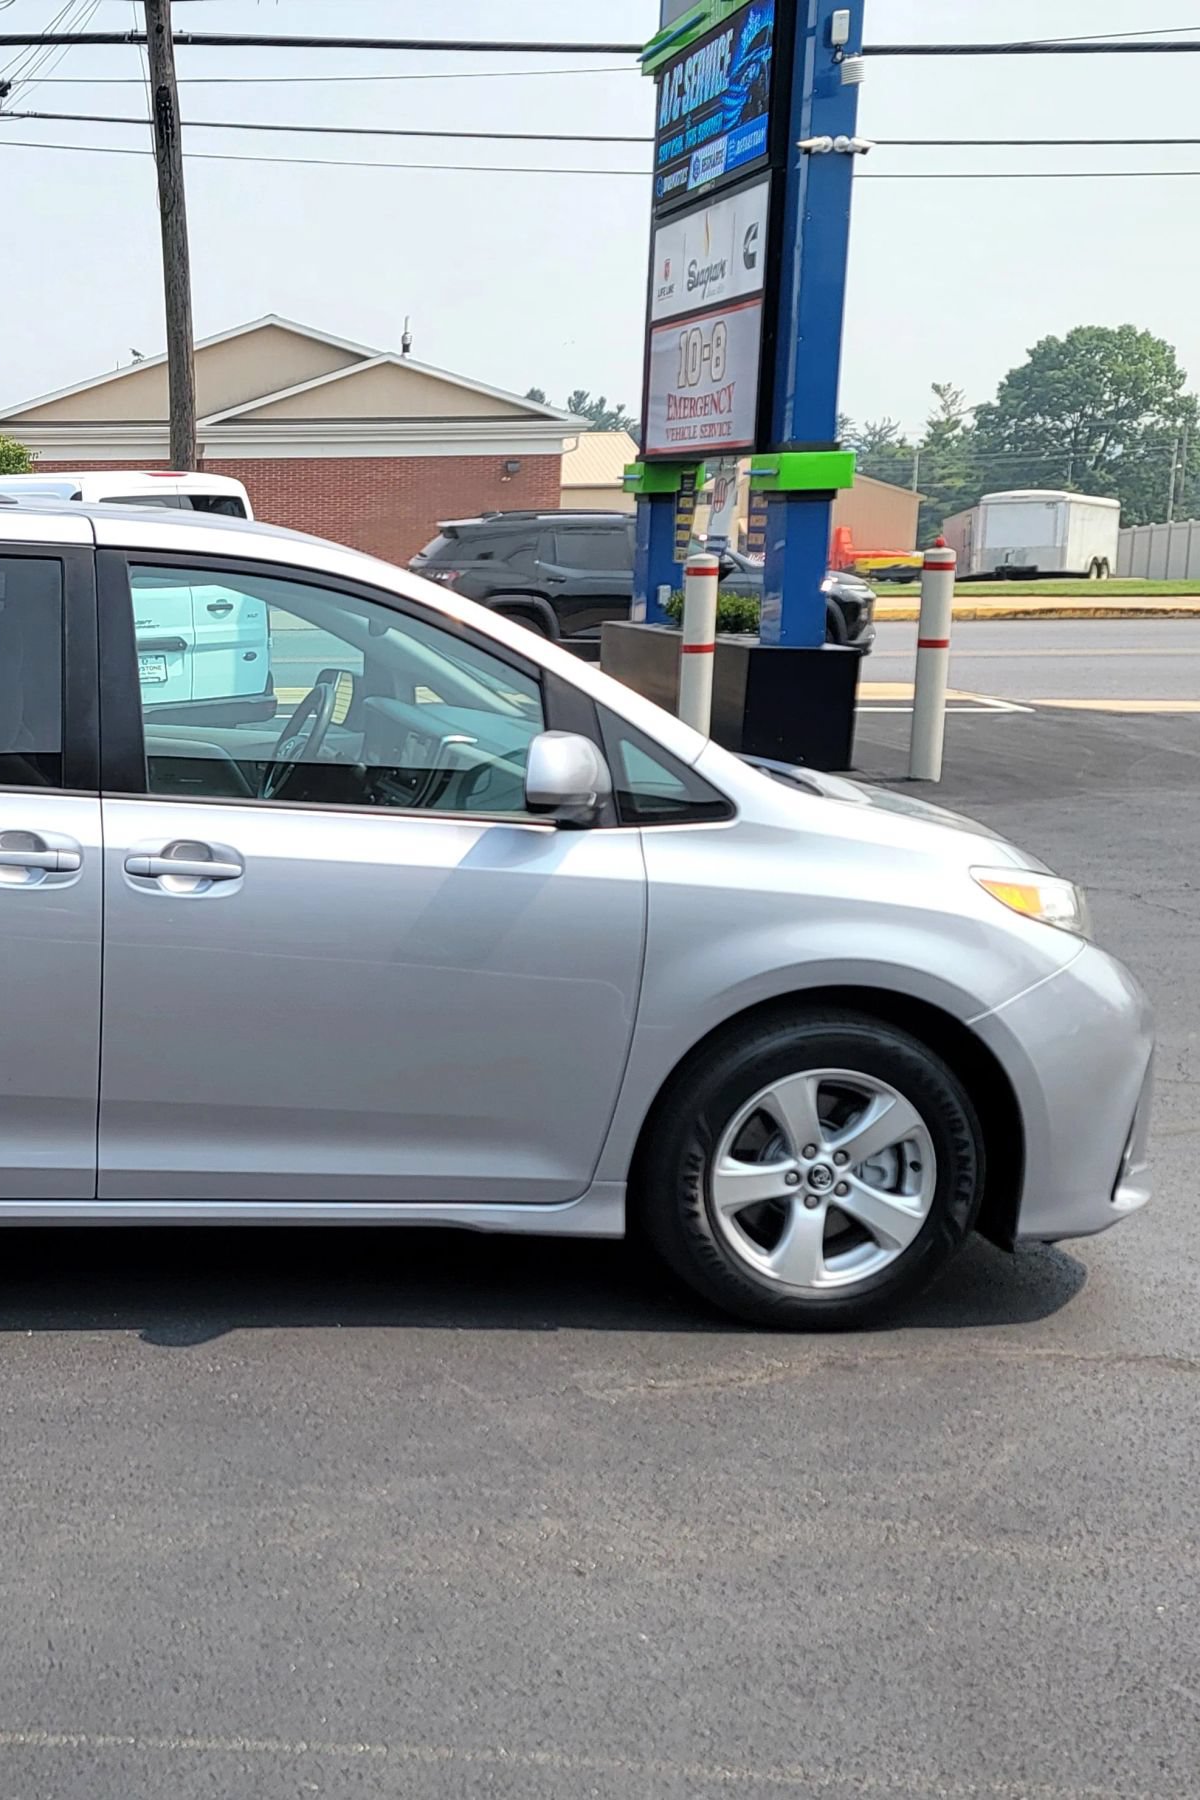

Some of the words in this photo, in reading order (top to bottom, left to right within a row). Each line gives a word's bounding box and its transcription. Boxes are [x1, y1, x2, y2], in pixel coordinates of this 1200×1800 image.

[659, 63, 684, 130] A/C
[682, 28, 734, 116] SERVICE
[677, 320, 727, 389] 10-8
[667, 381, 736, 421] EMERGENCY
[666, 424, 698, 441] VEHICLE
[700, 421, 733, 438] SERVICE
